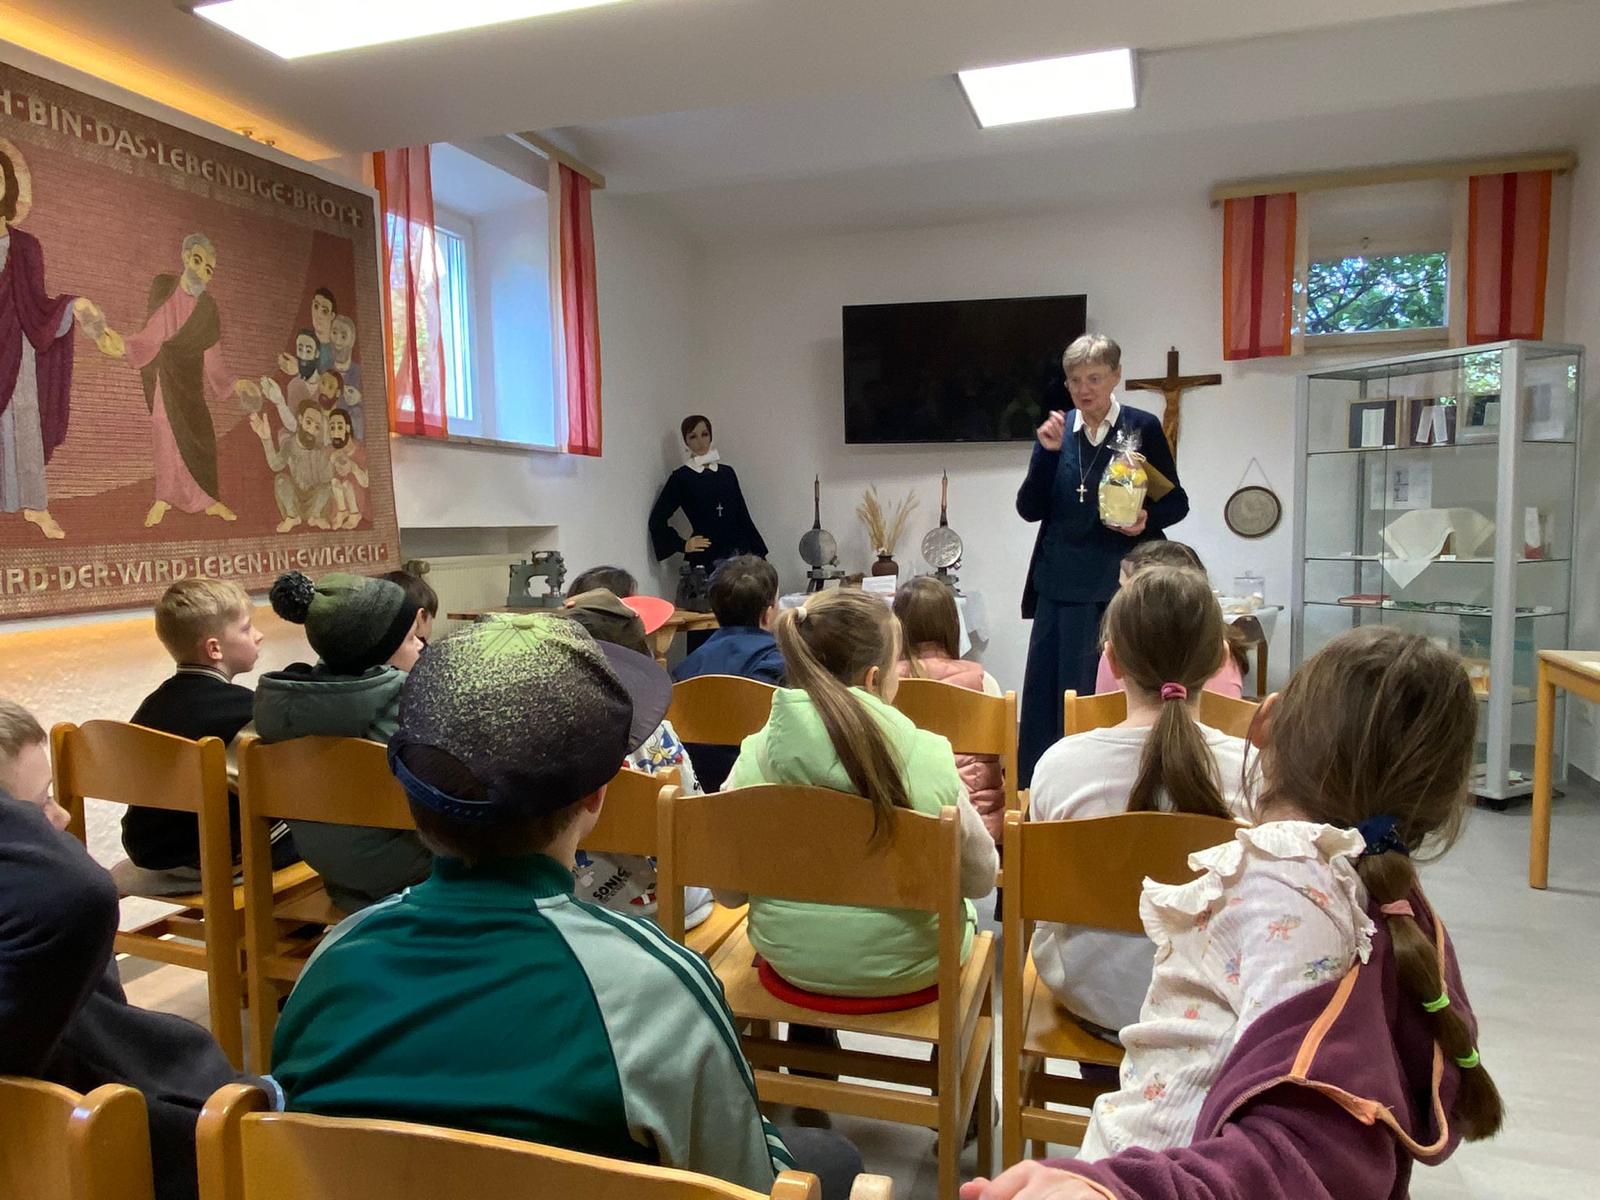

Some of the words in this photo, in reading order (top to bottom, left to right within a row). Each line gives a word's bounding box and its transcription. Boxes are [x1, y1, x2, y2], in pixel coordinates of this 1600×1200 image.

[28, 96, 82, 138] BIN
[95, 119, 148, 159] DAS
[158, 142, 286, 203] LEBENDIGE
[293, 188, 344, 222] BROT
[58, 562, 113, 590] DER
[115, 558, 188, 585] WIRD
[194, 552, 263, 580] LEBEN
[268, 550, 290, 572] IN
[296, 544, 380, 568] EWIGKEIT
[592, 865, 627, 901] SONIC
